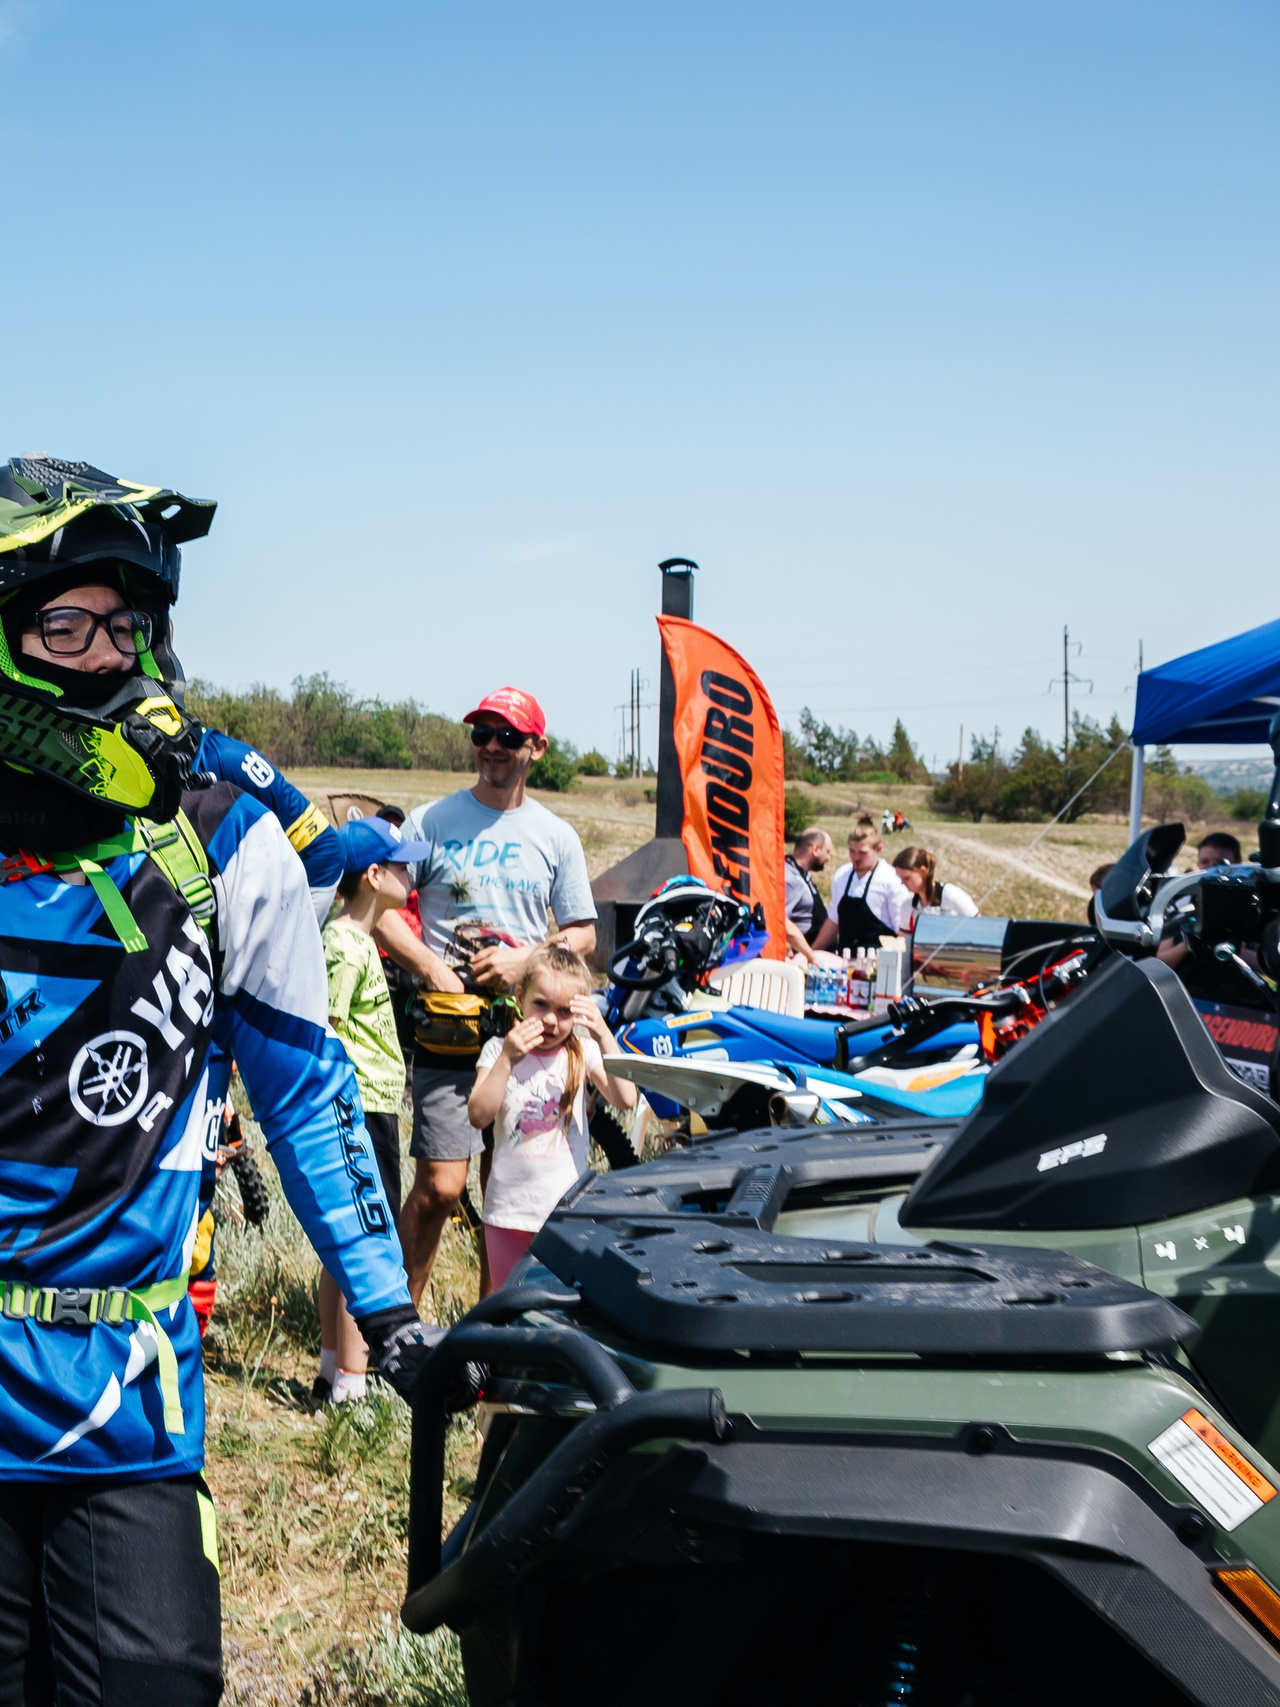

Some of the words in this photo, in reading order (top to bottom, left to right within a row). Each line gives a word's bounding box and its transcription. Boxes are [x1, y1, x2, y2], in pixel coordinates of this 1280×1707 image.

[443, 839, 522, 871] RIDE
[506, 877, 540, 894] WAVE
[1036, 1132, 1108, 1173] EPS
